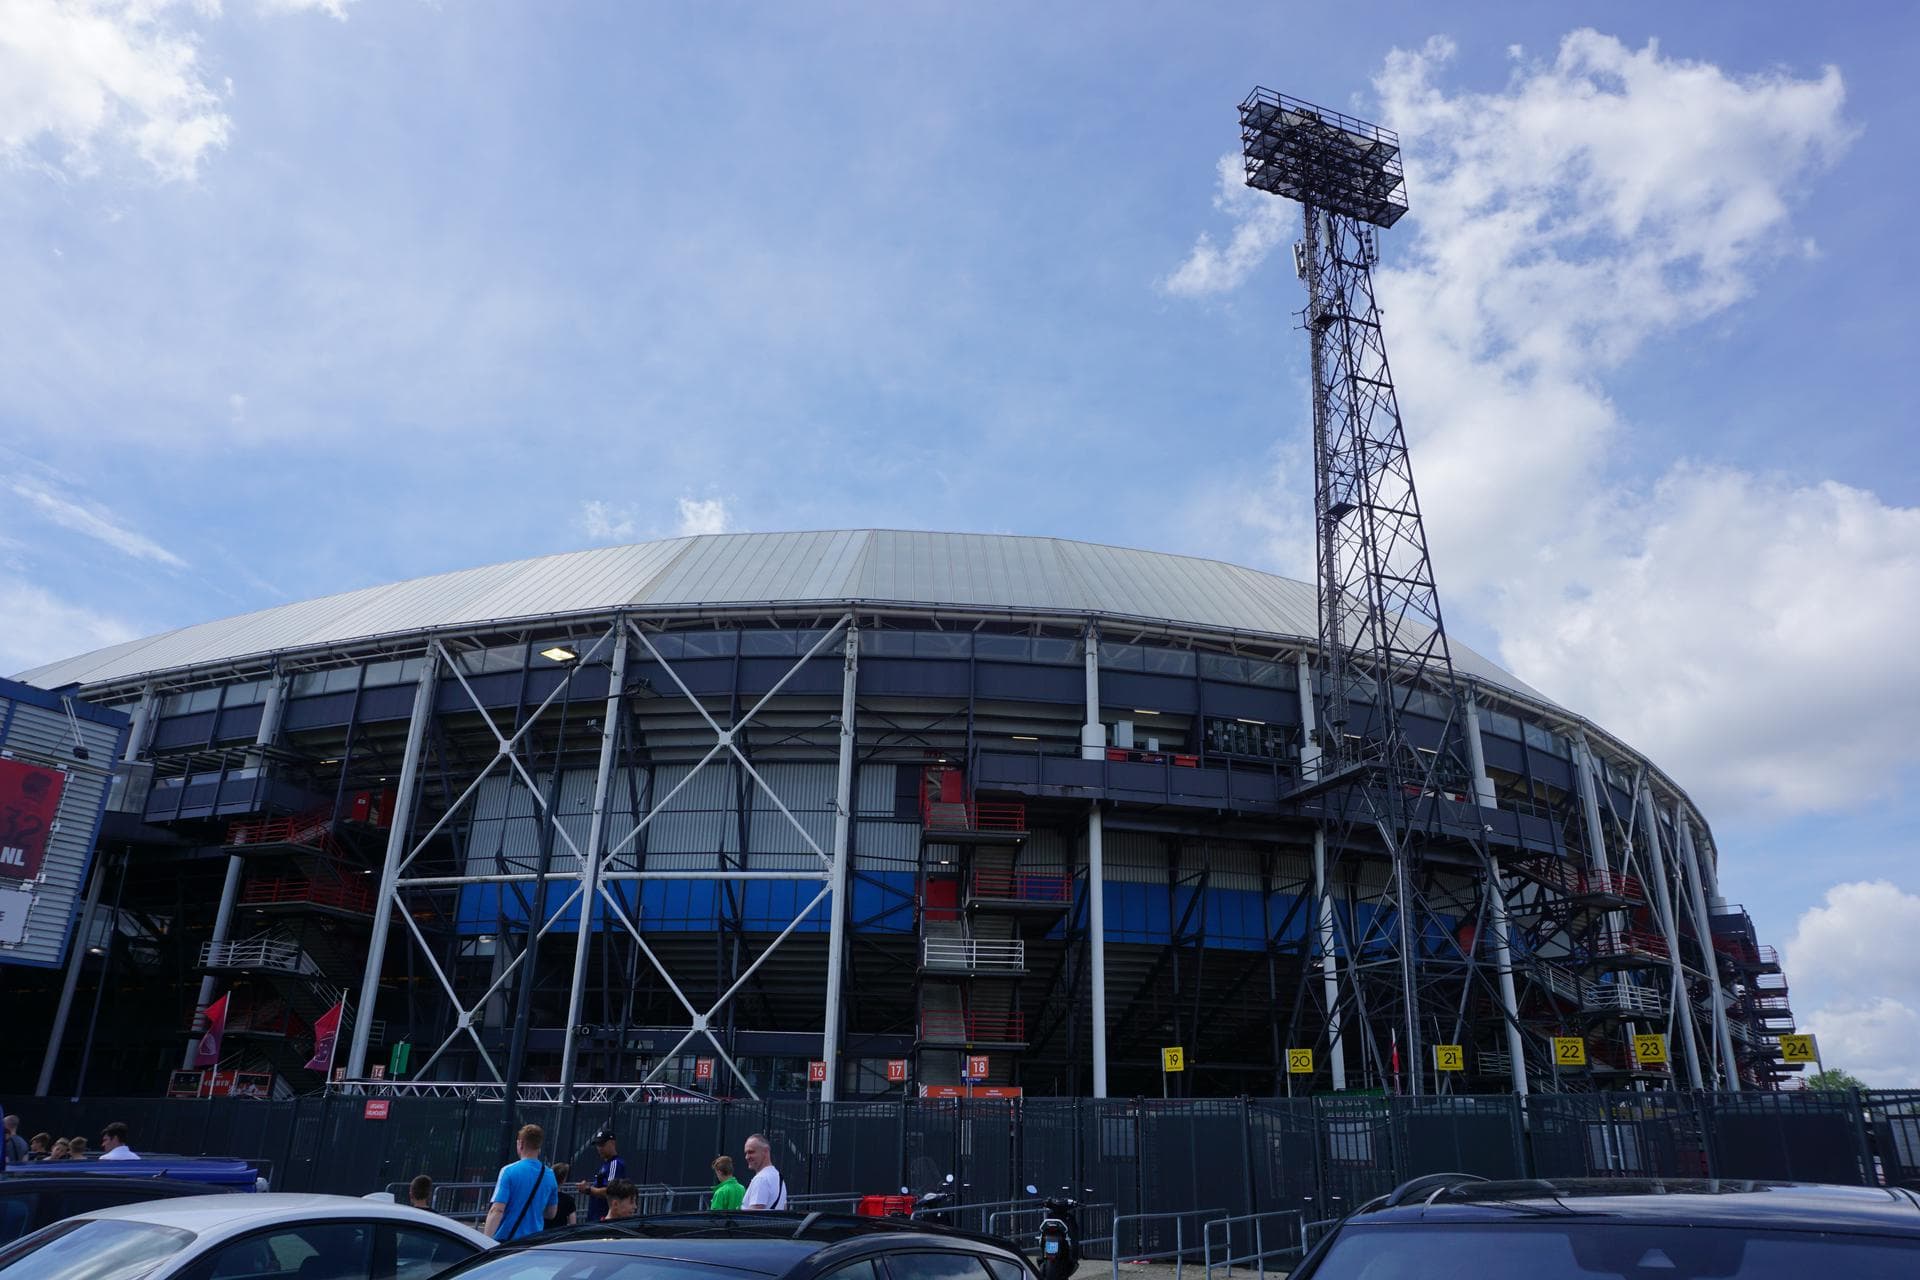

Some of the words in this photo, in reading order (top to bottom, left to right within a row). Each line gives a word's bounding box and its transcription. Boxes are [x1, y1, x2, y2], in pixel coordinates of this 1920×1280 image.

[1560, 1045, 1580, 1058] 22
[1640, 1042, 1660, 1056] 23
[1786, 1042, 1809, 1057] 24
[1168, 1053, 1179, 1066] 19
[1291, 1055, 1311, 1067] 20
[1443, 1052, 1457, 1065] 21
[699, 1064, 709, 1074] 15
[812, 1066, 824, 1077] 16
[890, 1065, 902, 1077] 17
[973, 1061, 985, 1073] 18
